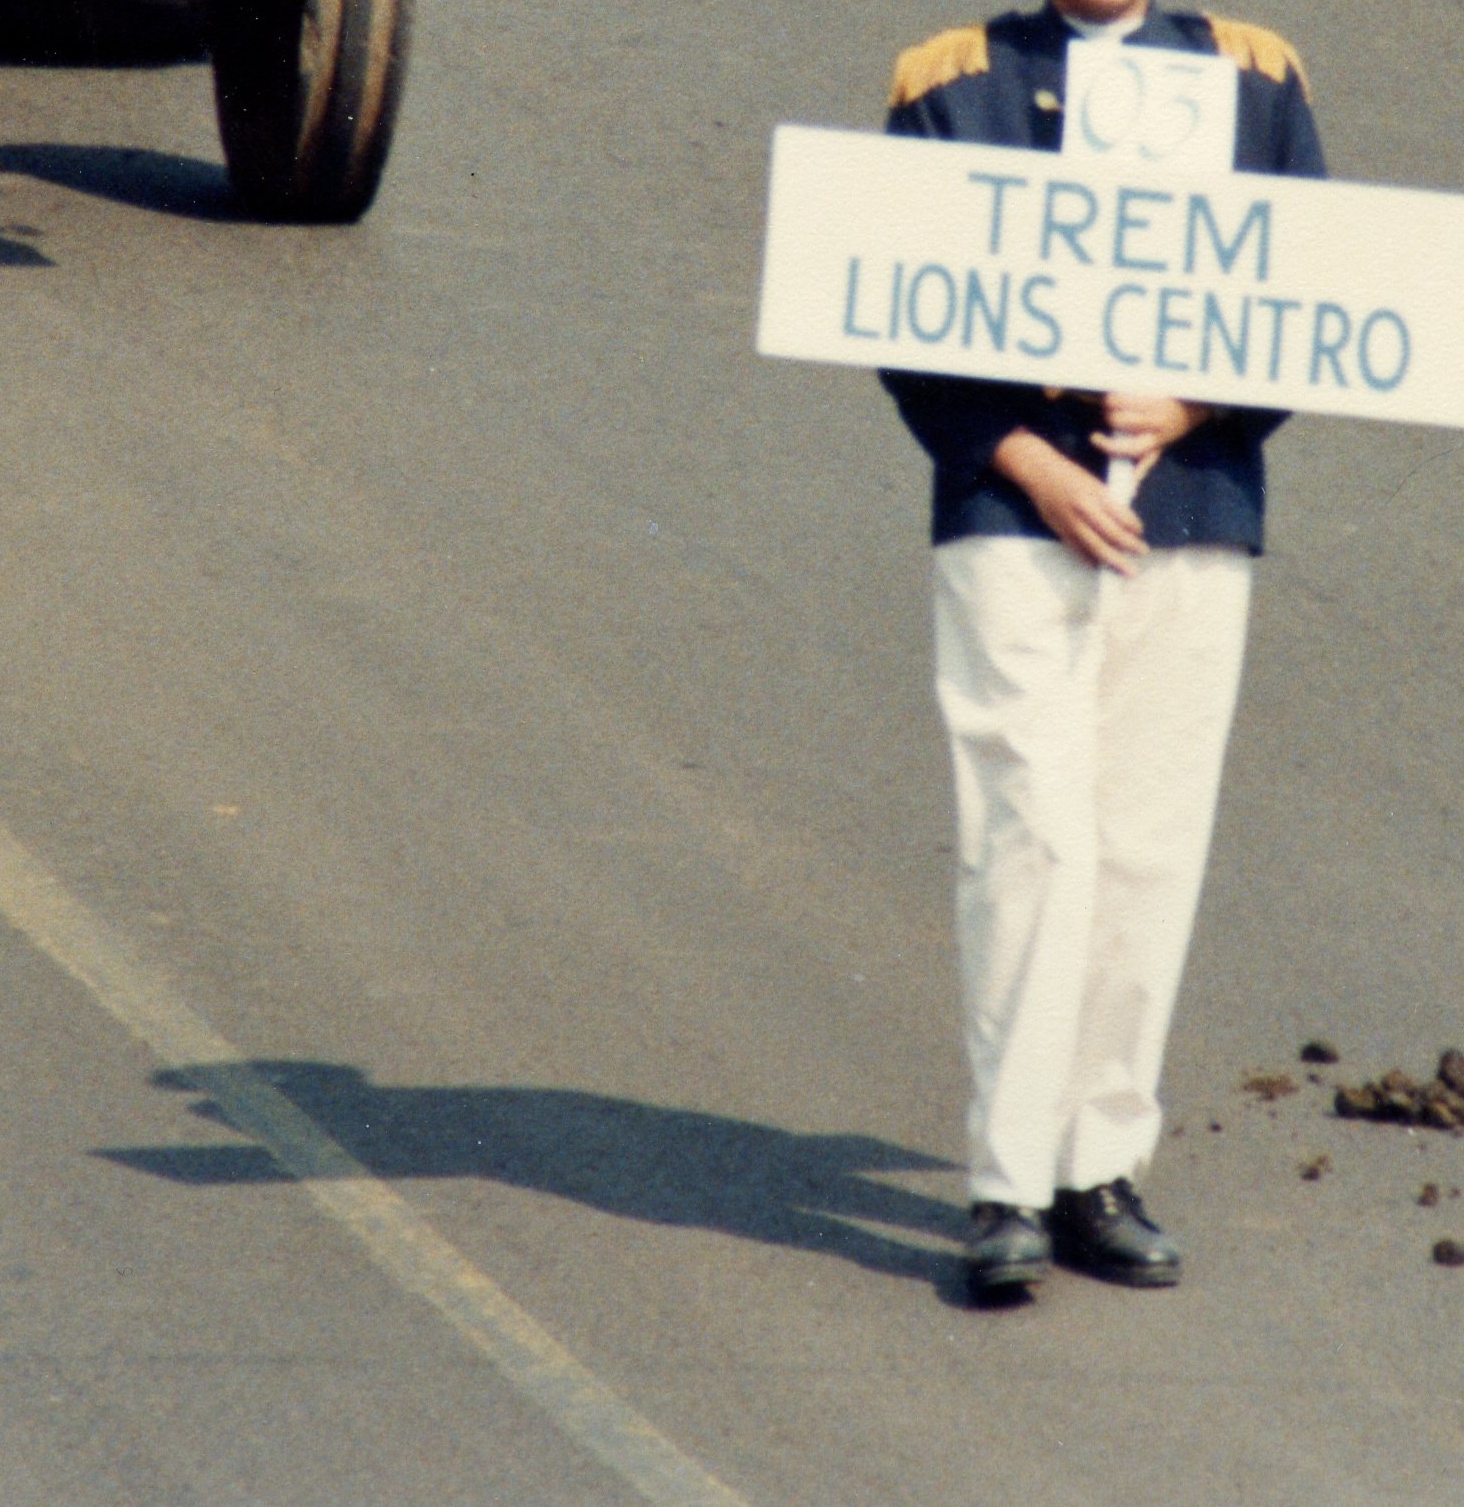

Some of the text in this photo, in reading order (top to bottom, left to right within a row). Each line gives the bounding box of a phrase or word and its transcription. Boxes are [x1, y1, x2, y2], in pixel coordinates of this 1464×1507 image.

[968, 171, 1271, 281] TREM
[843, 257, 1411, 391] LIONS CENTRO
